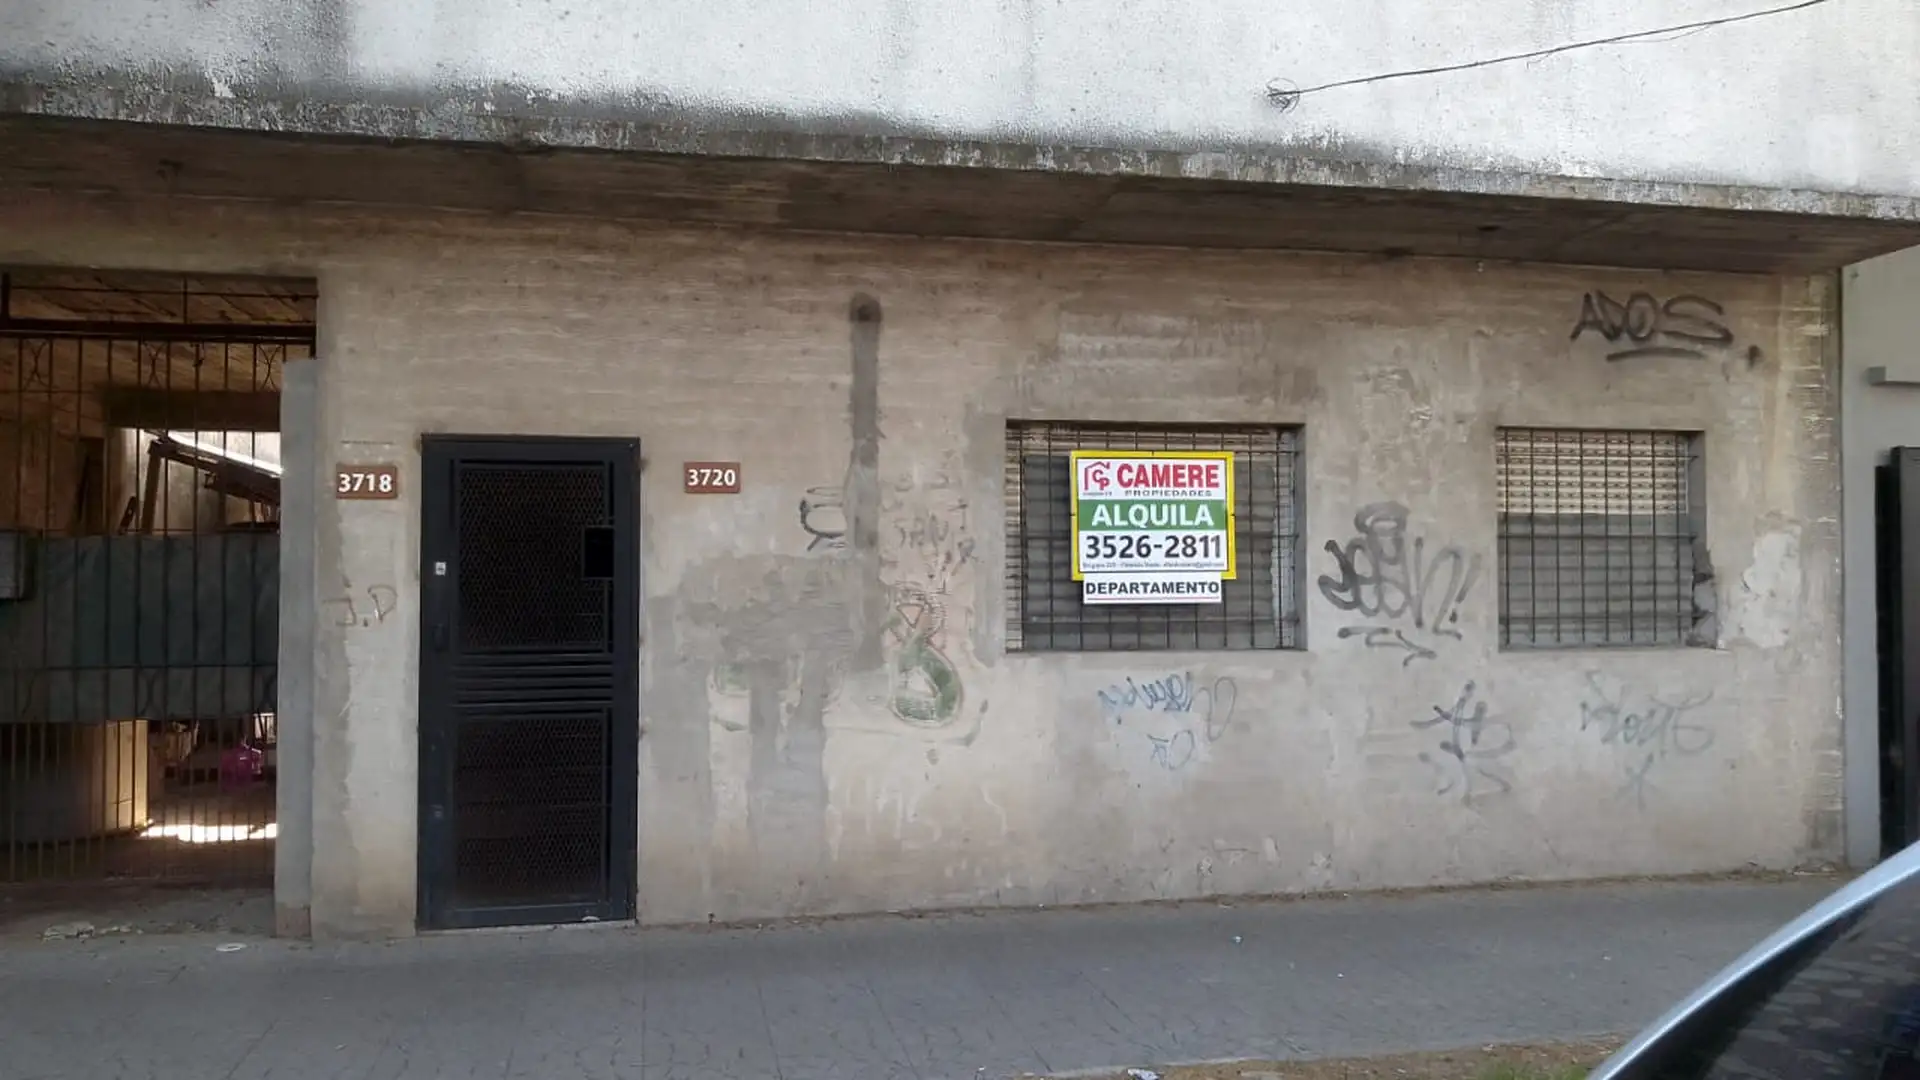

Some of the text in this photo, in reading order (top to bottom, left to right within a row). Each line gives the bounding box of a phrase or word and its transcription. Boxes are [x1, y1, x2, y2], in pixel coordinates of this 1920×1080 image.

[338, 473, 393, 492] 3718
[687, 469, 736, 486] 3720
[1117, 463, 1220, 488] CAMERE
[1092, 504, 1214, 528] ALQUILA
[1085, 535, 1221, 559] 3526-2811
[1086, 581, 1219, 594] DEPARTAMENTO
